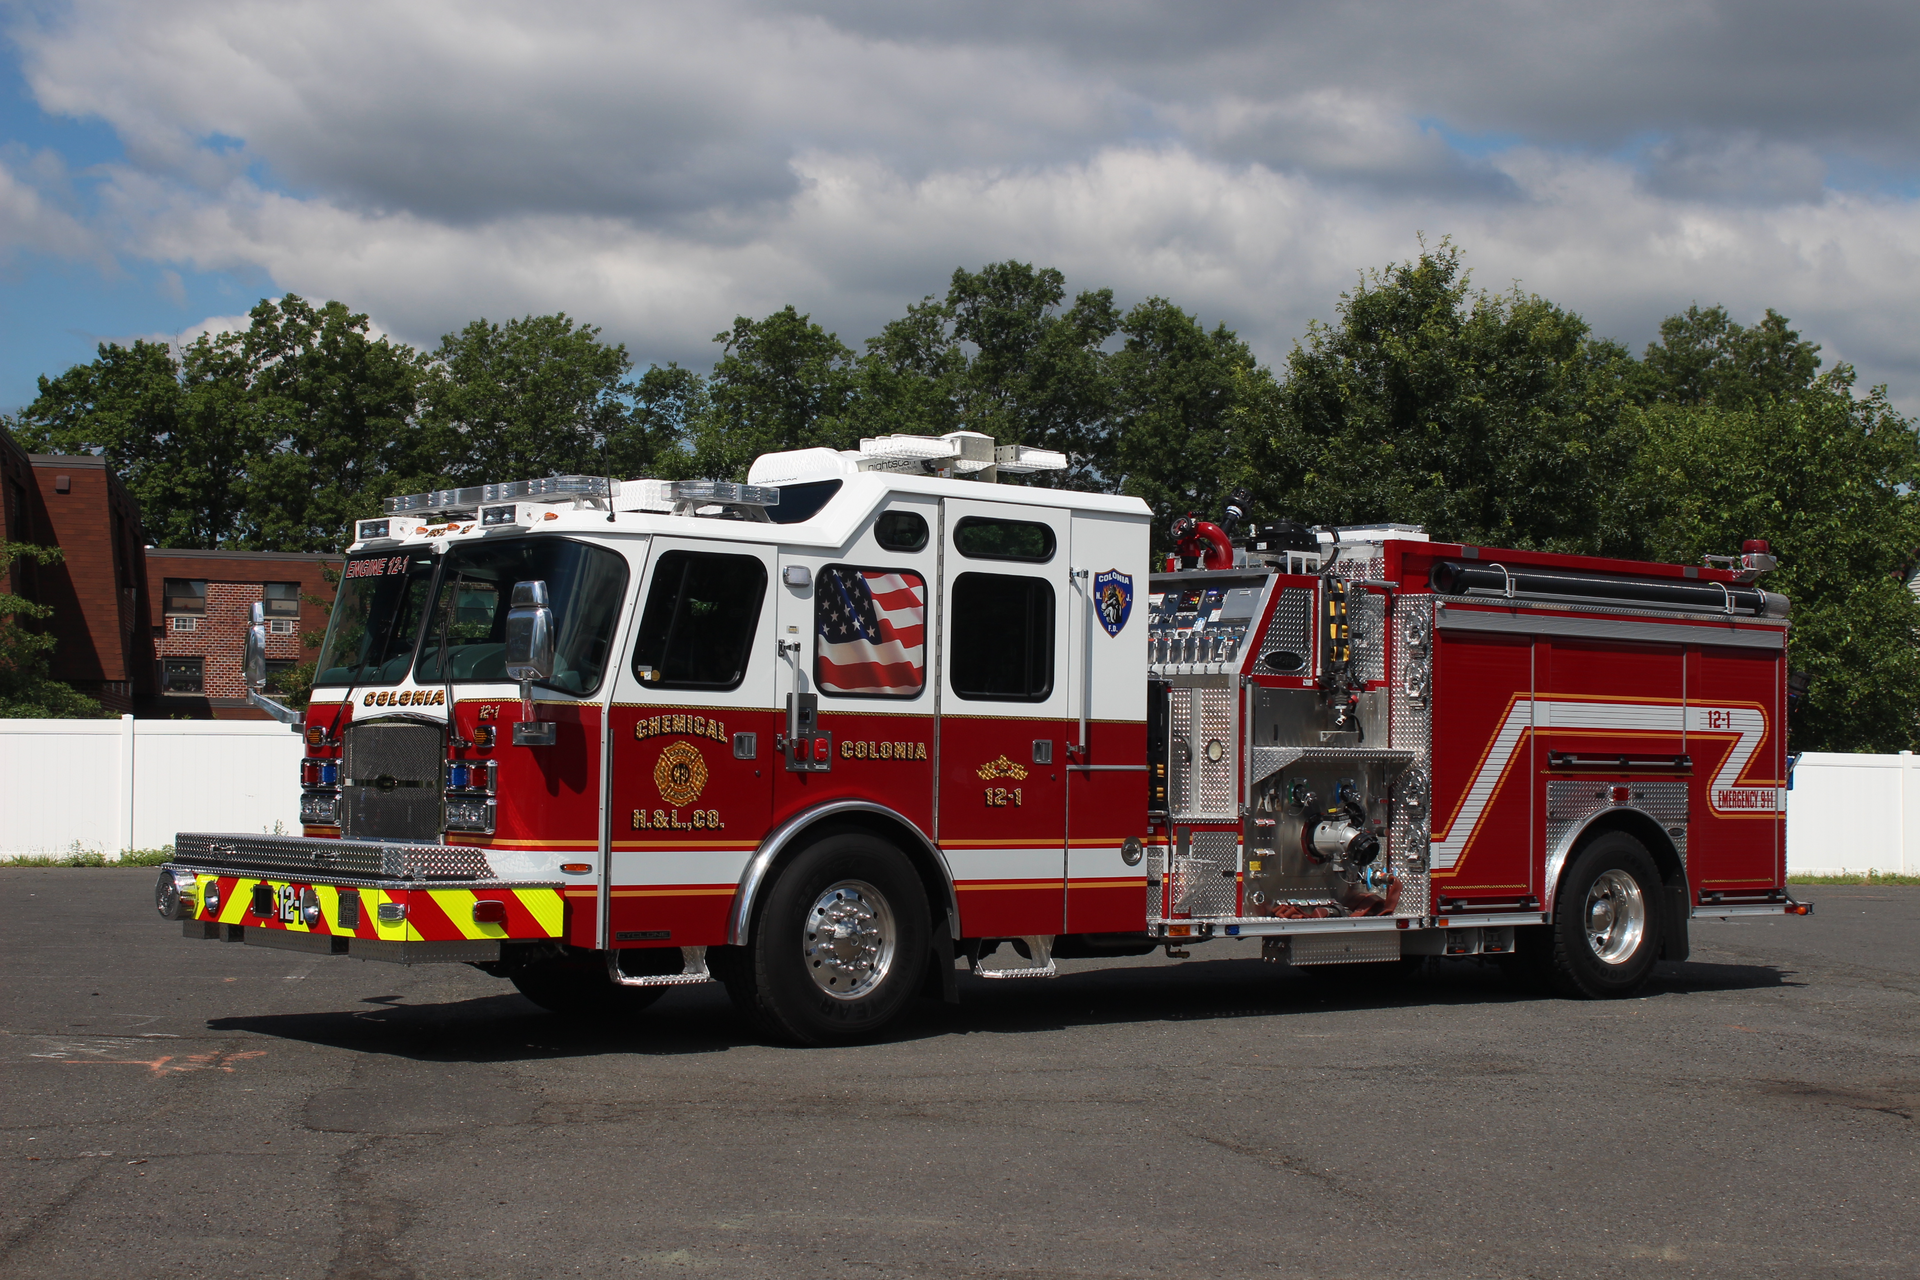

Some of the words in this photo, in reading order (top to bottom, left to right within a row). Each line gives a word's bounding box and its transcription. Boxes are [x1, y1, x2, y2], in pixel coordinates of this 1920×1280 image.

[345, 557, 388, 579] ENGINE
[387, 555, 410, 575] 12-1
[1098, 571, 1130, 585] COLONIA
[1107, 624, 1119, 633] F.D.
[363, 690, 445, 707] COLONIA
[479, 704, 501, 720] 12-1
[1707, 710, 1731, 729] 12-1
[635, 714, 728, 743] CHEMICAL
[840, 740, 927, 760] COLONIA
[984, 787, 1022, 807] 12-1
[1718, 790, 1759, 809] EMERGENCY
[278, 885, 306, 923] 12-1
